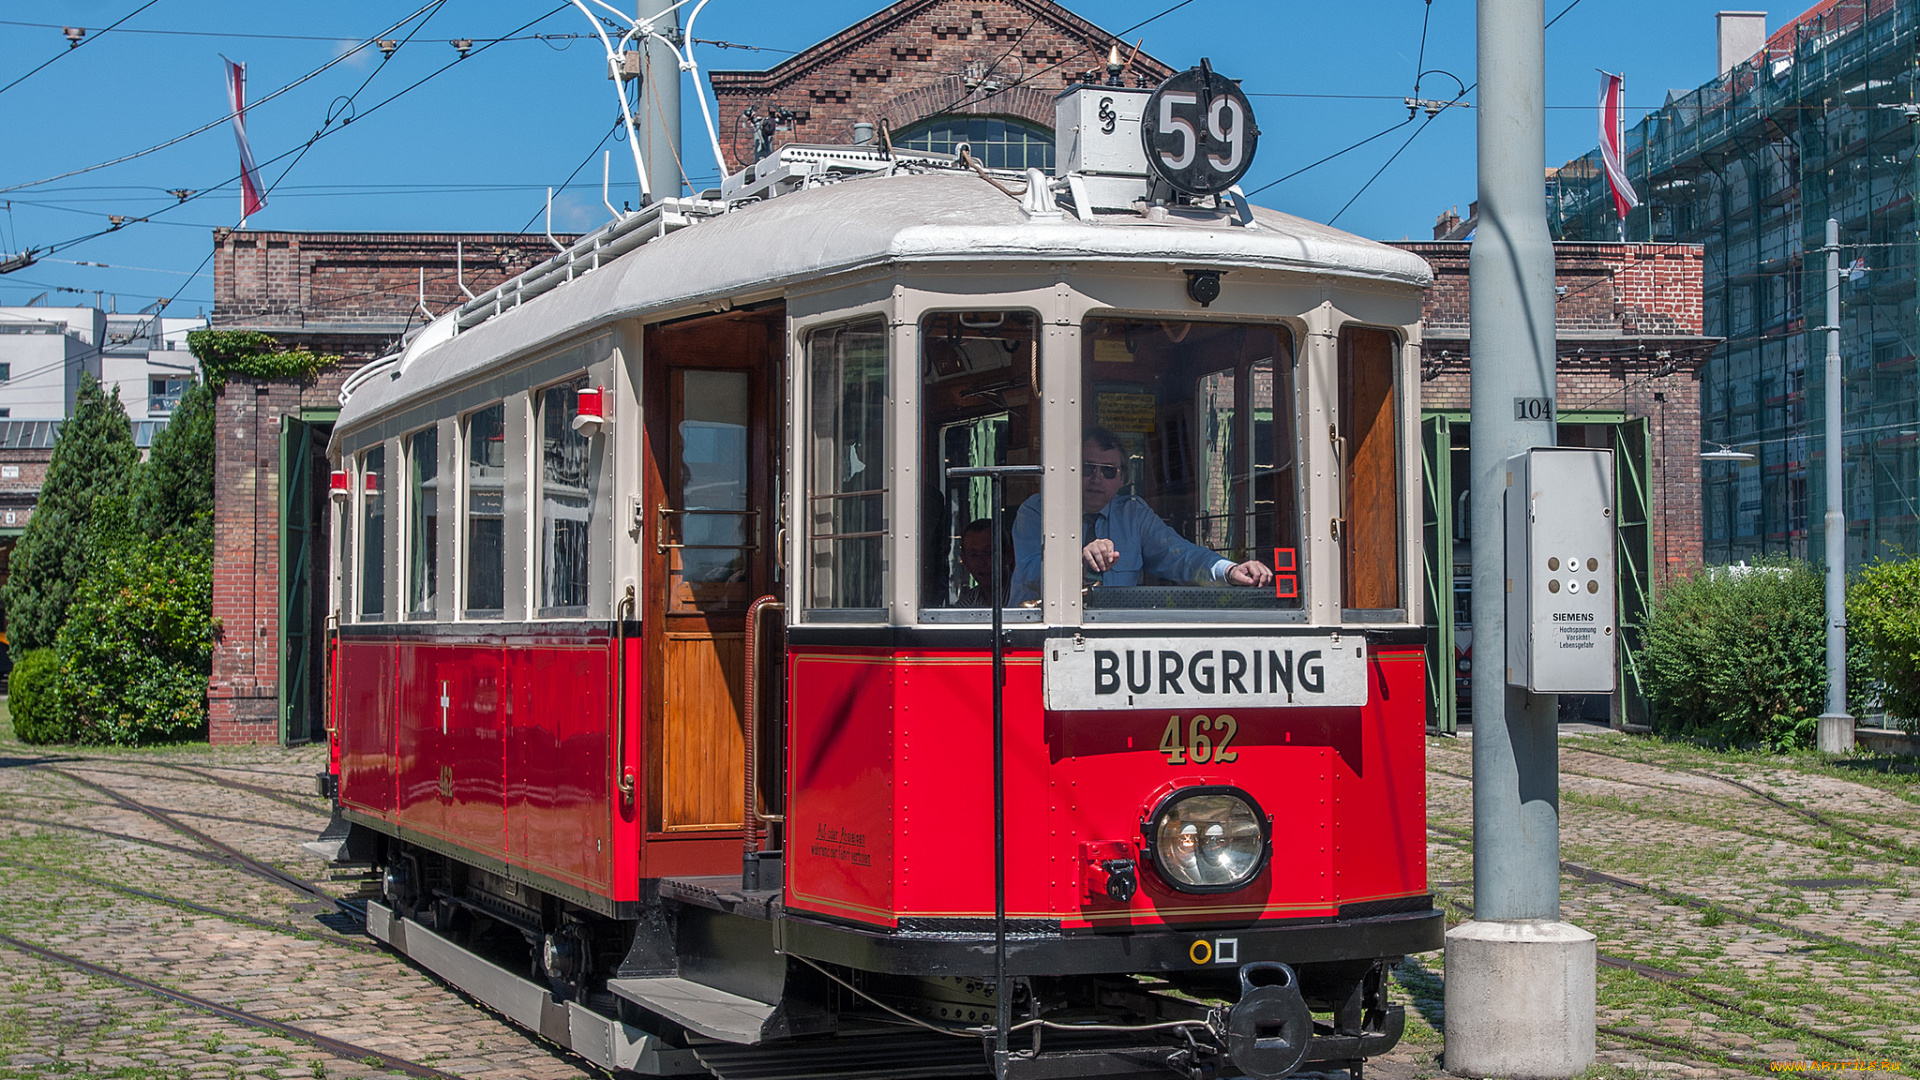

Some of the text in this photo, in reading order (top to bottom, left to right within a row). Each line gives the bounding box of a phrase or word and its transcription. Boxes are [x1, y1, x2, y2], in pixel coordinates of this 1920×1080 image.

[1159, 92, 1243, 173] 59
[1517, 399, 1552, 420] 104
[1552, 613, 1594, 621] SIEMENS
[1559, 626, 1597, 634] Hochspannung
[1559, 641, 1595, 650] Lebensgefahr
[1094, 650, 1325, 695] BURGRING
[1159, 714, 1239, 765] 462
[439, 765, 453, 798] 462
